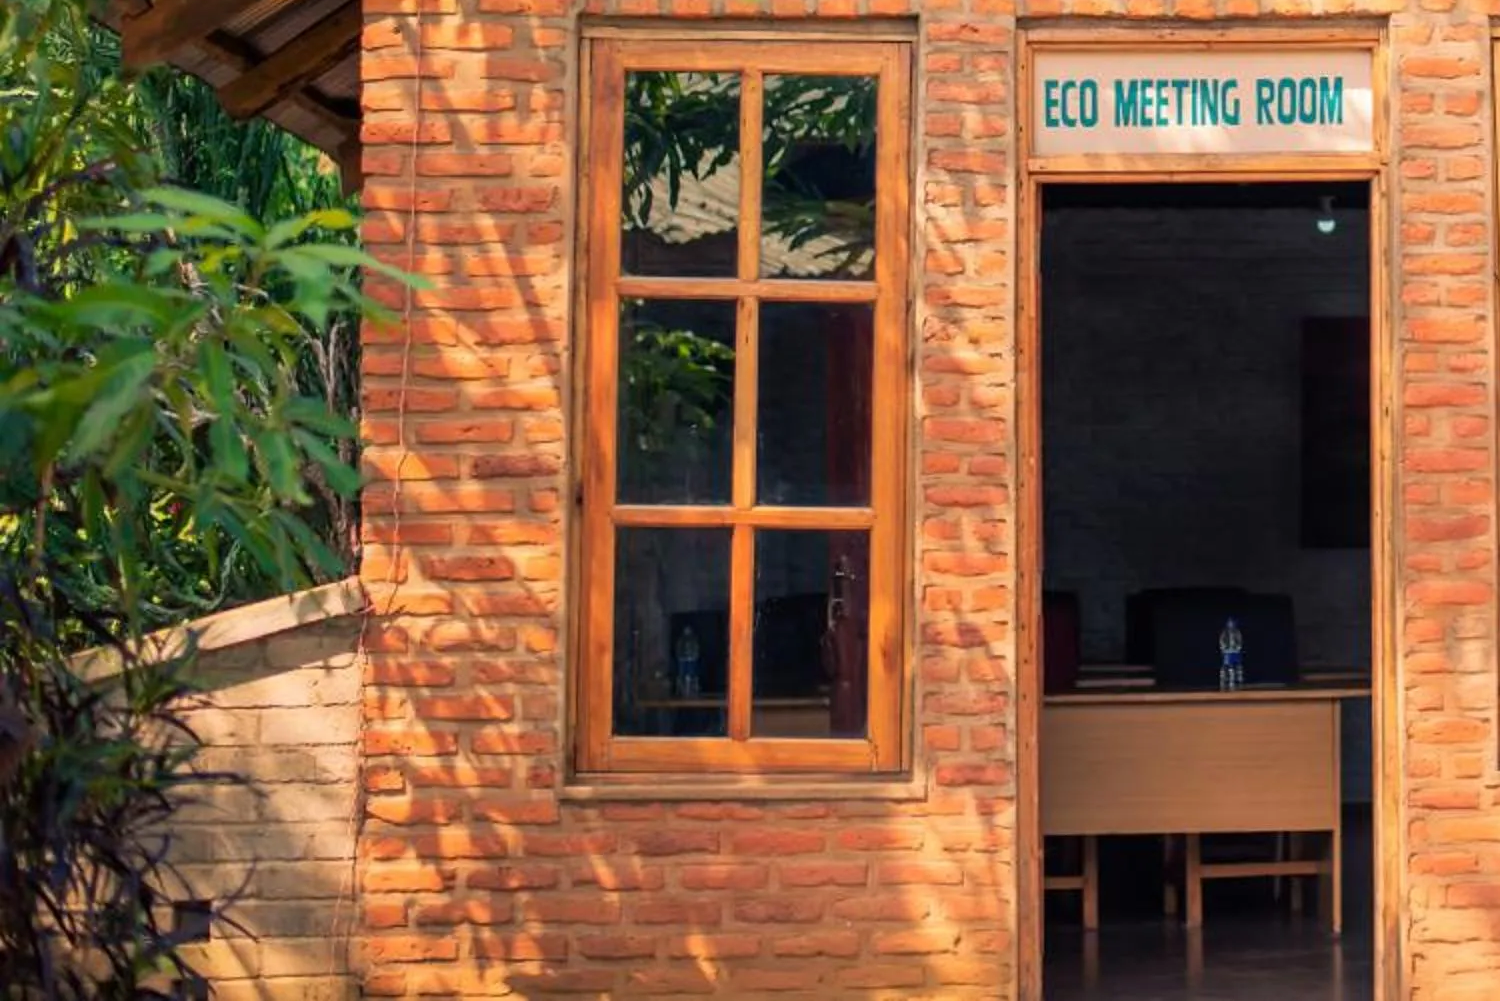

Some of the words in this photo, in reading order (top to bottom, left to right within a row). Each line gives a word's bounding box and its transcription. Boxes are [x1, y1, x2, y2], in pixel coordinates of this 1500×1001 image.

[1044, 79, 1099, 128] ECO
[1113, 78, 1241, 127] MEETING
[1256, 77, 1344, 125] ROOM
